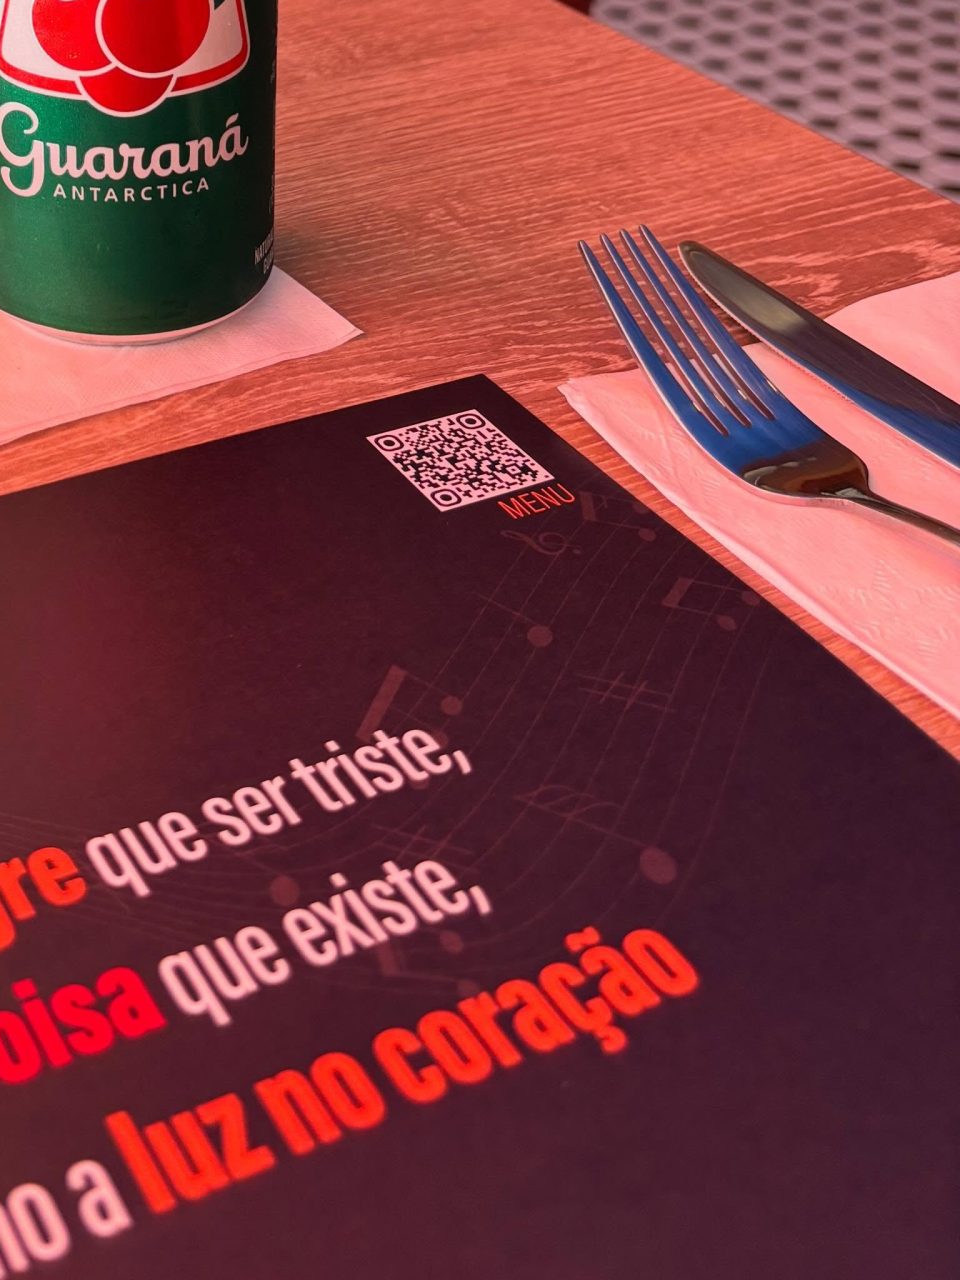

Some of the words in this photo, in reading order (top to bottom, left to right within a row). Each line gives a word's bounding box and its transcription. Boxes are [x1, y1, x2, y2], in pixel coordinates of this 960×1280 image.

[53, 177, 210, 202] ANTARCTICA
[496, 483, 576, 520] MENU
[84, 809, 208, 897] que
[200, 773, 304, 849] ser
[288, 726, 473, 814] triste,
[157, 922, 291, 1027] que
[281, 853, 493, 970] existe,
[66, 1158, 133, 1239] a
[105, 1085, 276, 1217] luz
[252, 1050, 388, 1157] no
[372, 926, 700, 1105] coração
